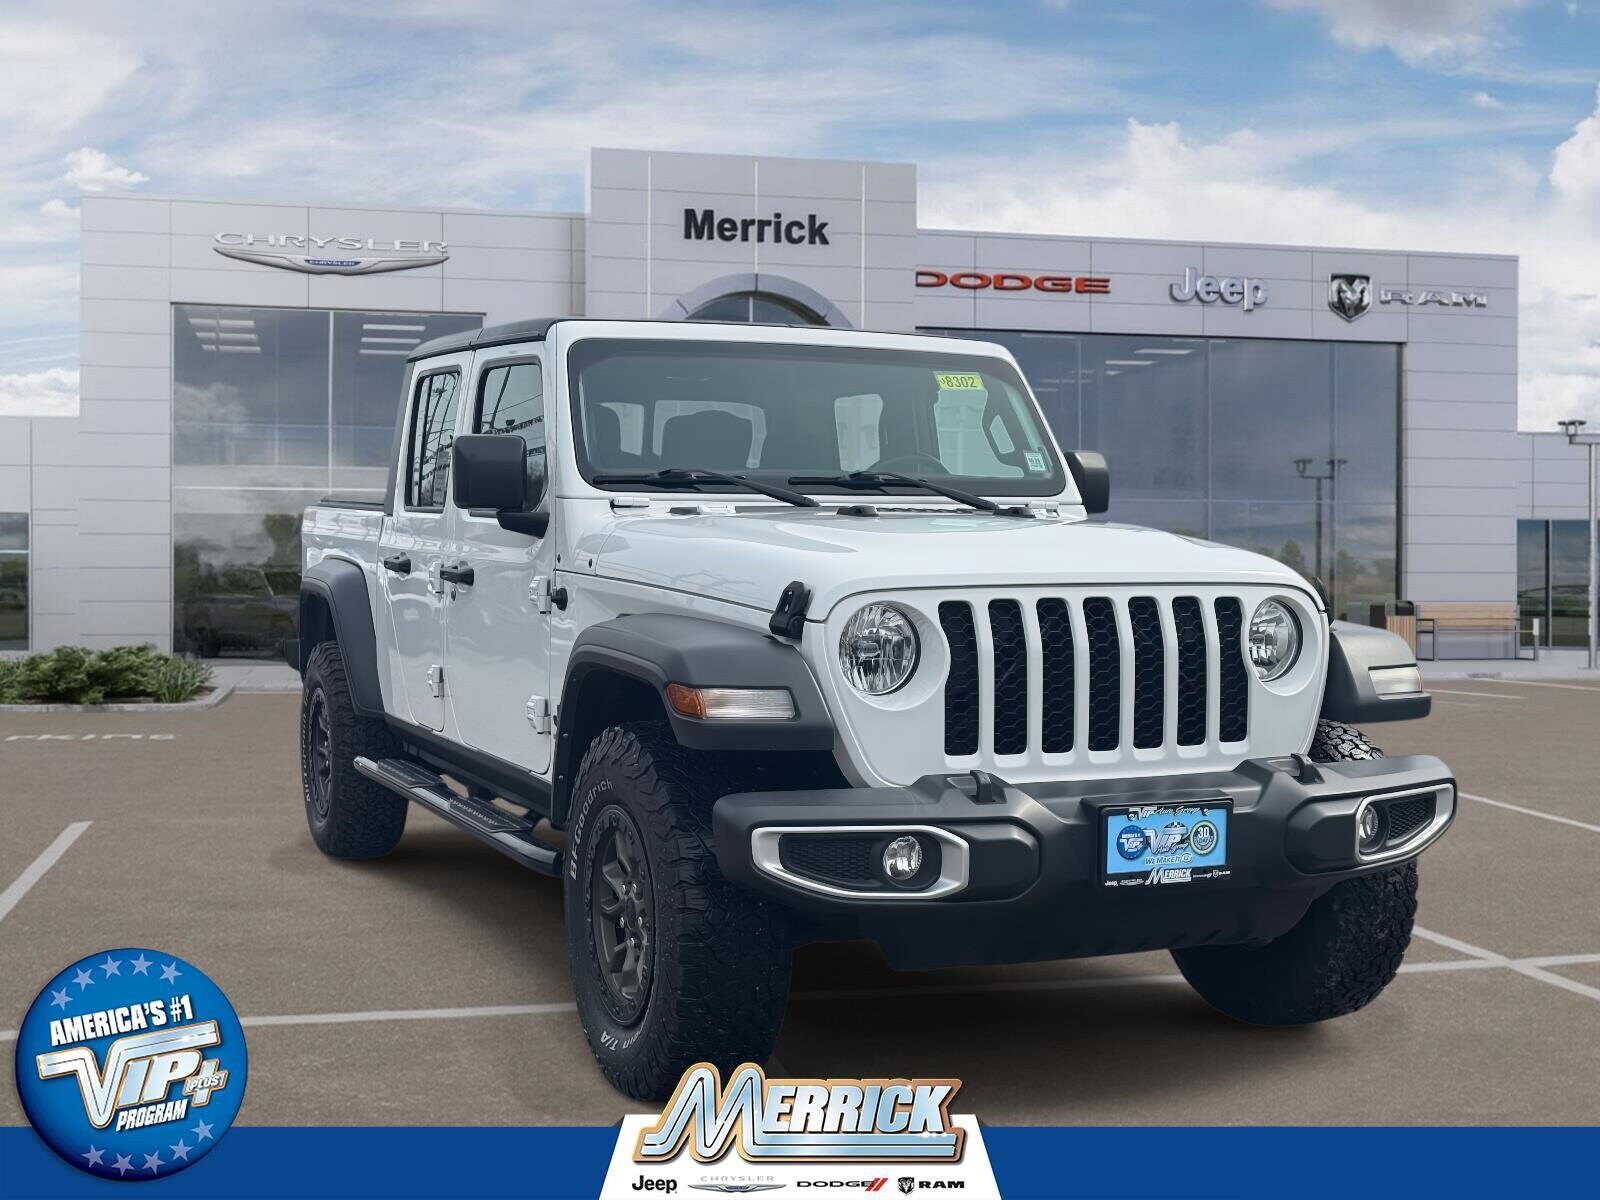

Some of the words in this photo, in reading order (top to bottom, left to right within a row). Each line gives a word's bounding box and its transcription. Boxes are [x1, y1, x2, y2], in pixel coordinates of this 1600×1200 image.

[684, 208, 829, 245] Merrick
[214, 232, 449, 253] CHRYSLER
[915, 271, 1111, 294] DODGE
[1170, 266, 1269, 311] Jeep
[1379, 289, 1487, 307] RAM
[1198, 827, 1210, 838] 30
[1145, 867, 1192, 886] MERRICK
